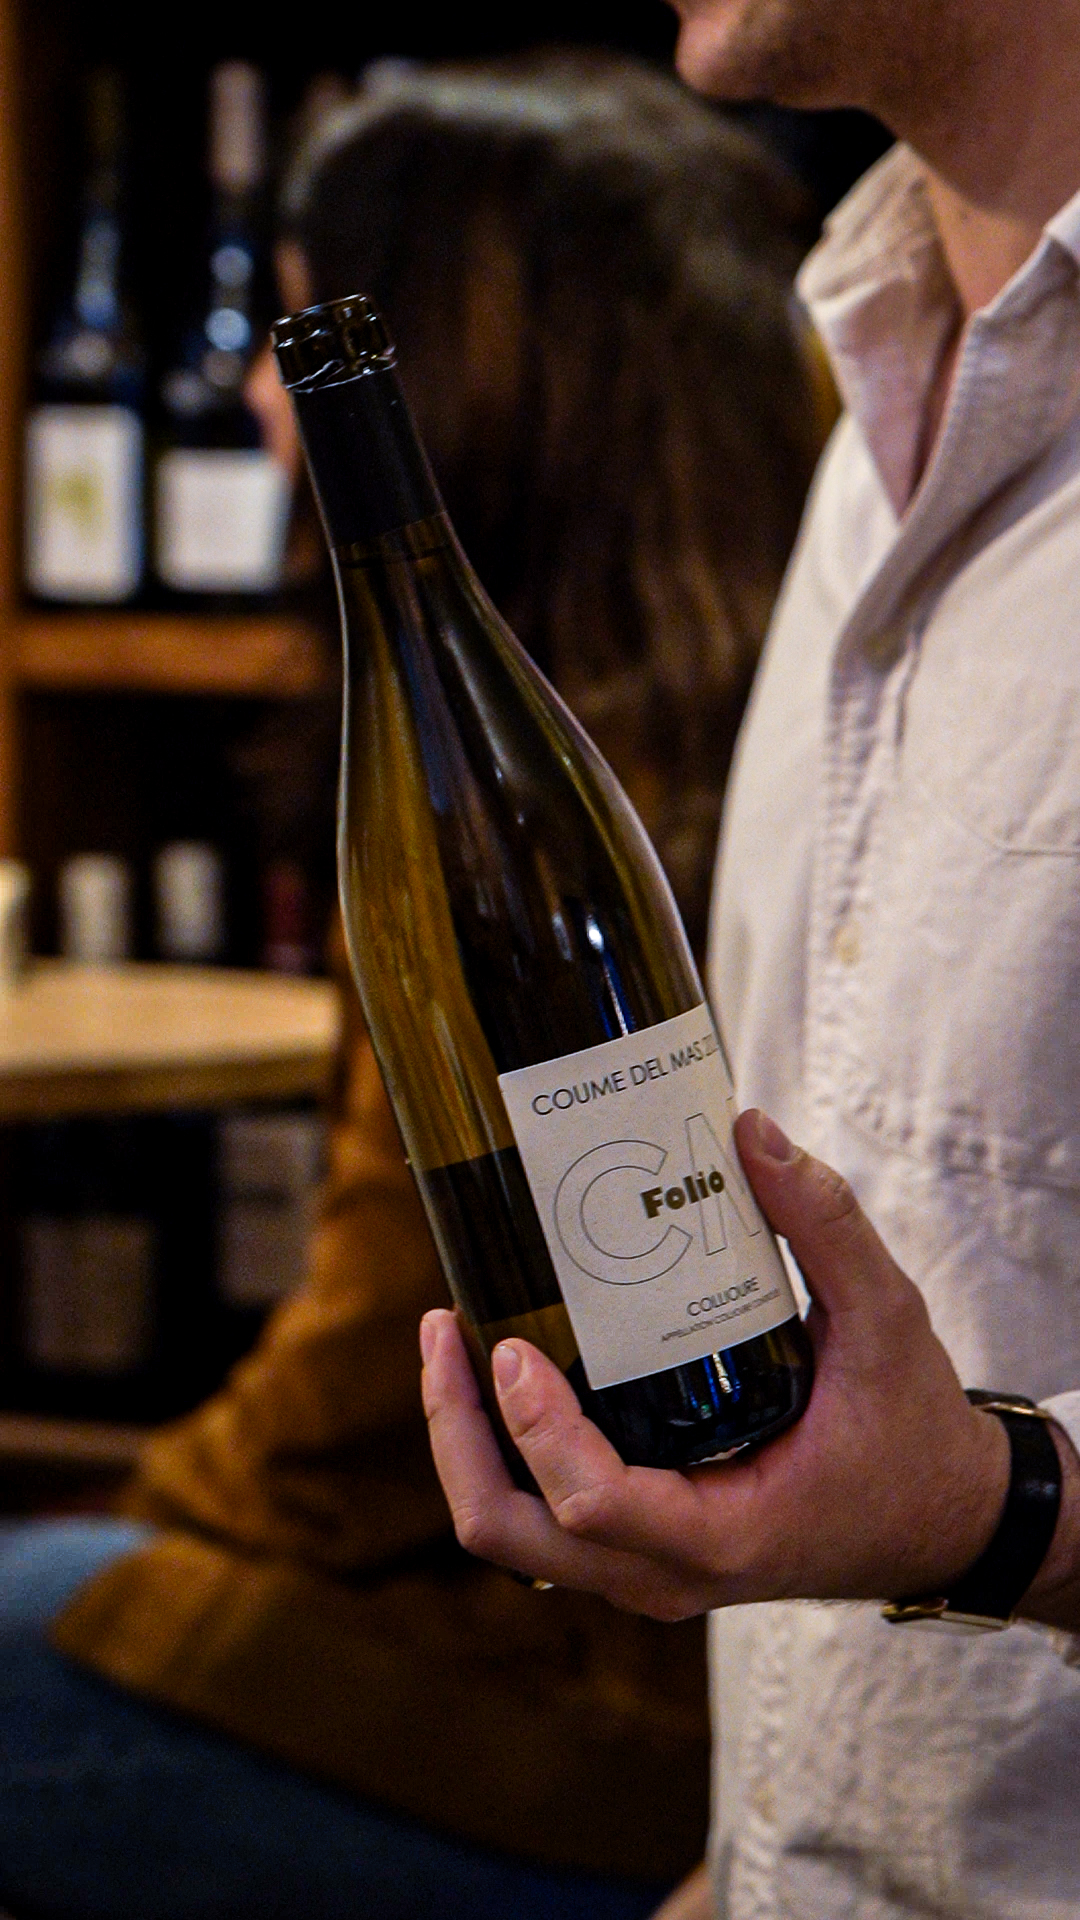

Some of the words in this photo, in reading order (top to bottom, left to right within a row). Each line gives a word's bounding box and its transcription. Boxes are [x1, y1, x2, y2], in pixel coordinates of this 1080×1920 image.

[531, 1070, 627, 1116] COUME
[629, 1057, 669, 1087] DEL
[669, 1040, 704, 1072] MAS
[640, 1170, 725, 1220] Folio
[686, 1275, 760, 1317] COLLIOURE
